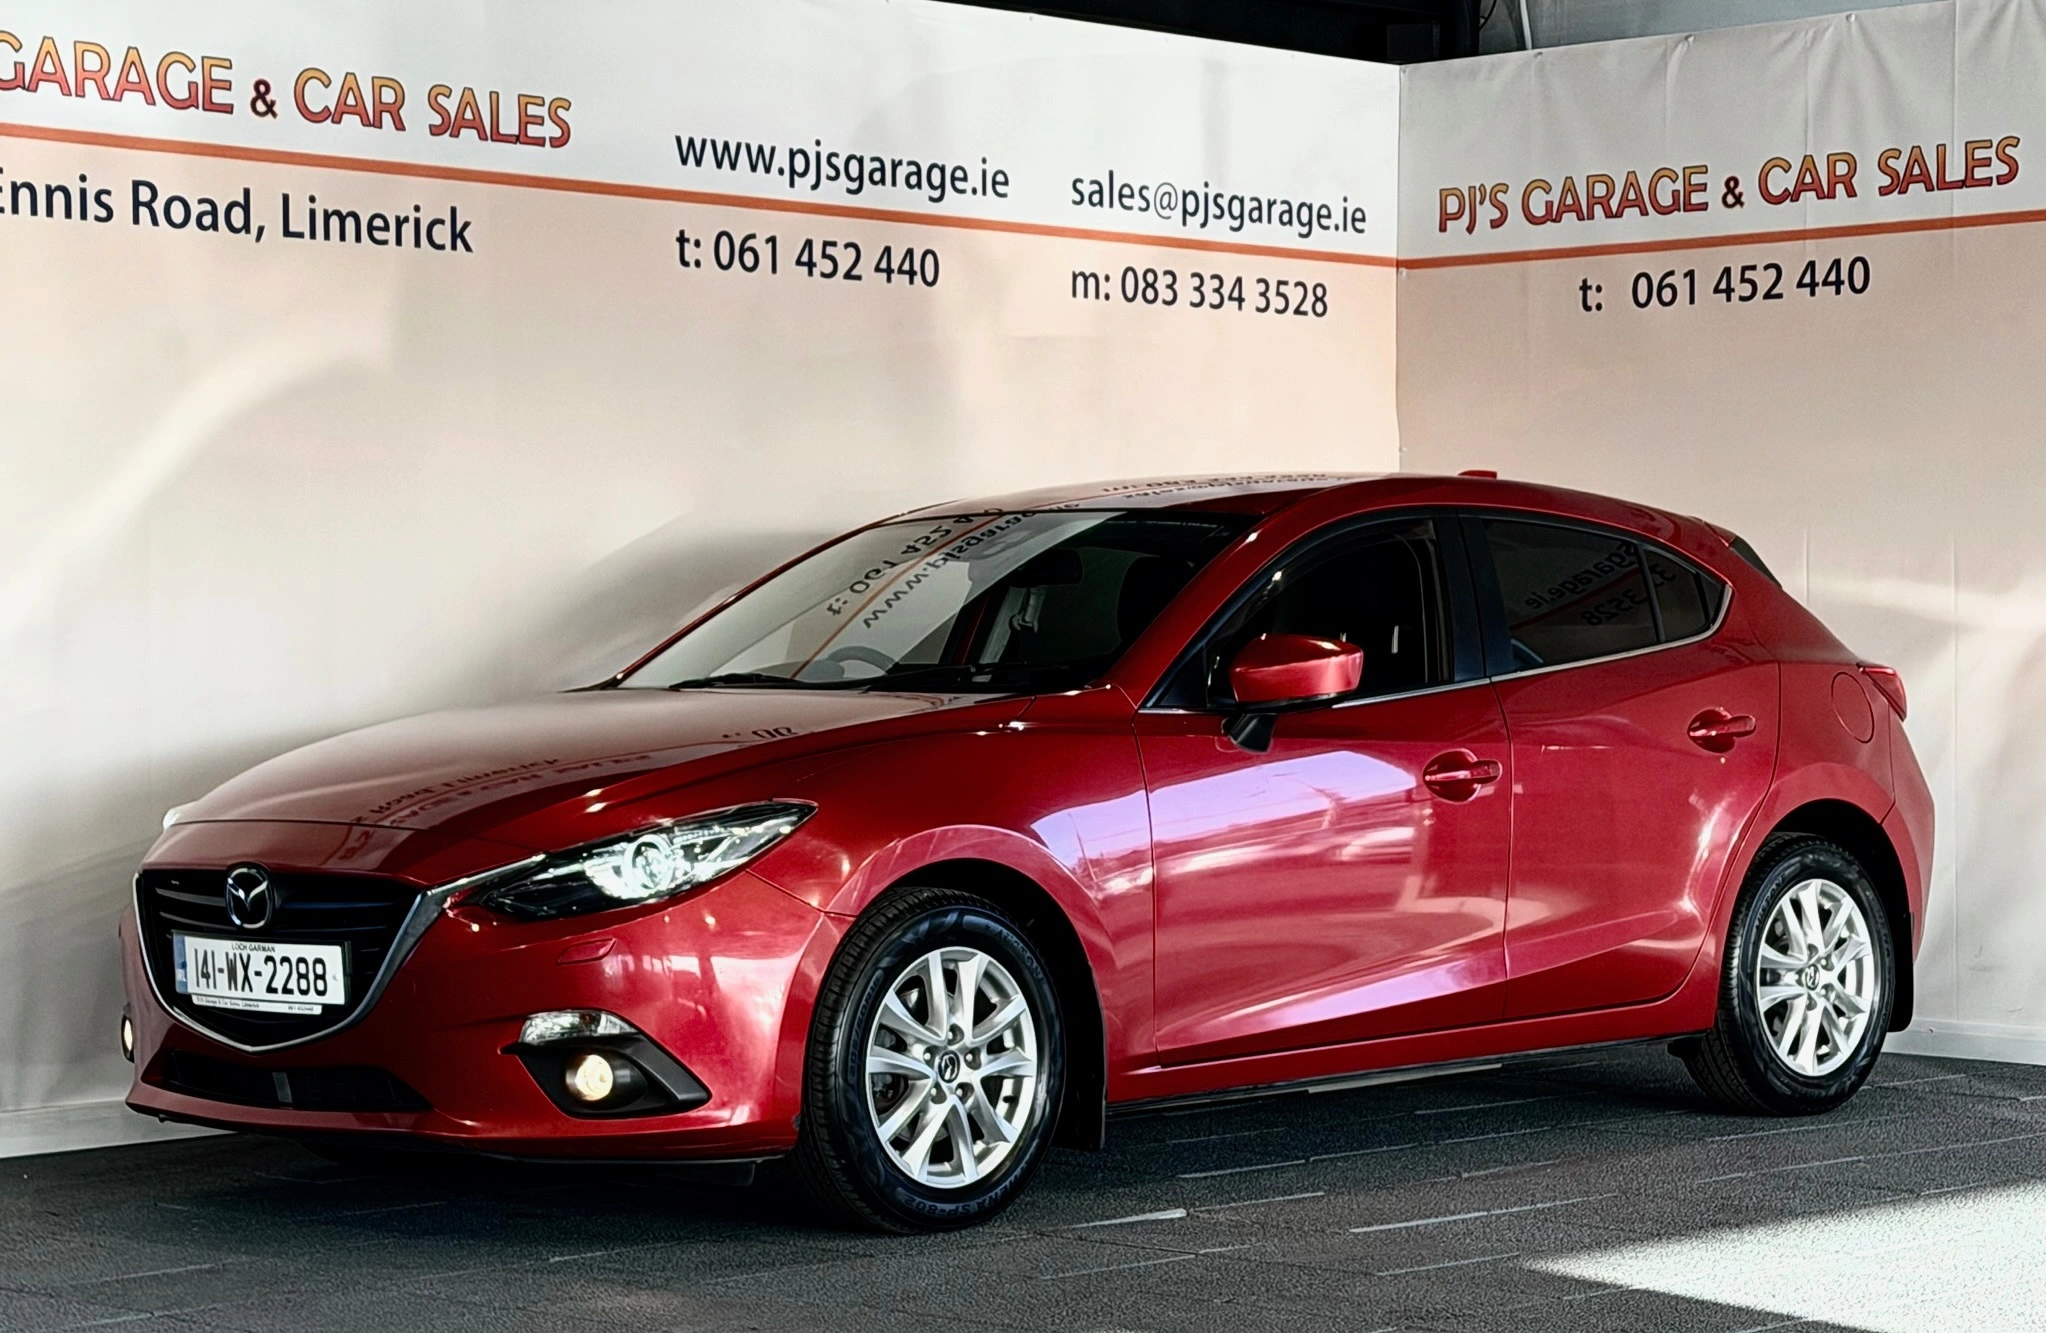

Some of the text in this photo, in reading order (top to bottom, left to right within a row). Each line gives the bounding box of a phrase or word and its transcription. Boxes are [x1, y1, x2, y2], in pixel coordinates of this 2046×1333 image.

[0, 29, 572, 149] GARAGE & CAR SALES
[675, 134, 1010, 204] www.pjsgarage.ie
[1438, 135, 2021, 236] PJ'S GARAGE & CAR SALES
[0, 166, 474, 254] nnis Road, Limerick
[1071, 169, 1367, 240] sales@pjsgarage.ie
[675, 228, 940, 288] t: 061 452 440
[1578, 255, 1871, 313] t: 061 452 440
[1071, 265, 1328, 318] m: 083 334 3528
[193, 947, 328, 997] 141-WX-2288
[248, 944, 276, 953] GARMAN
